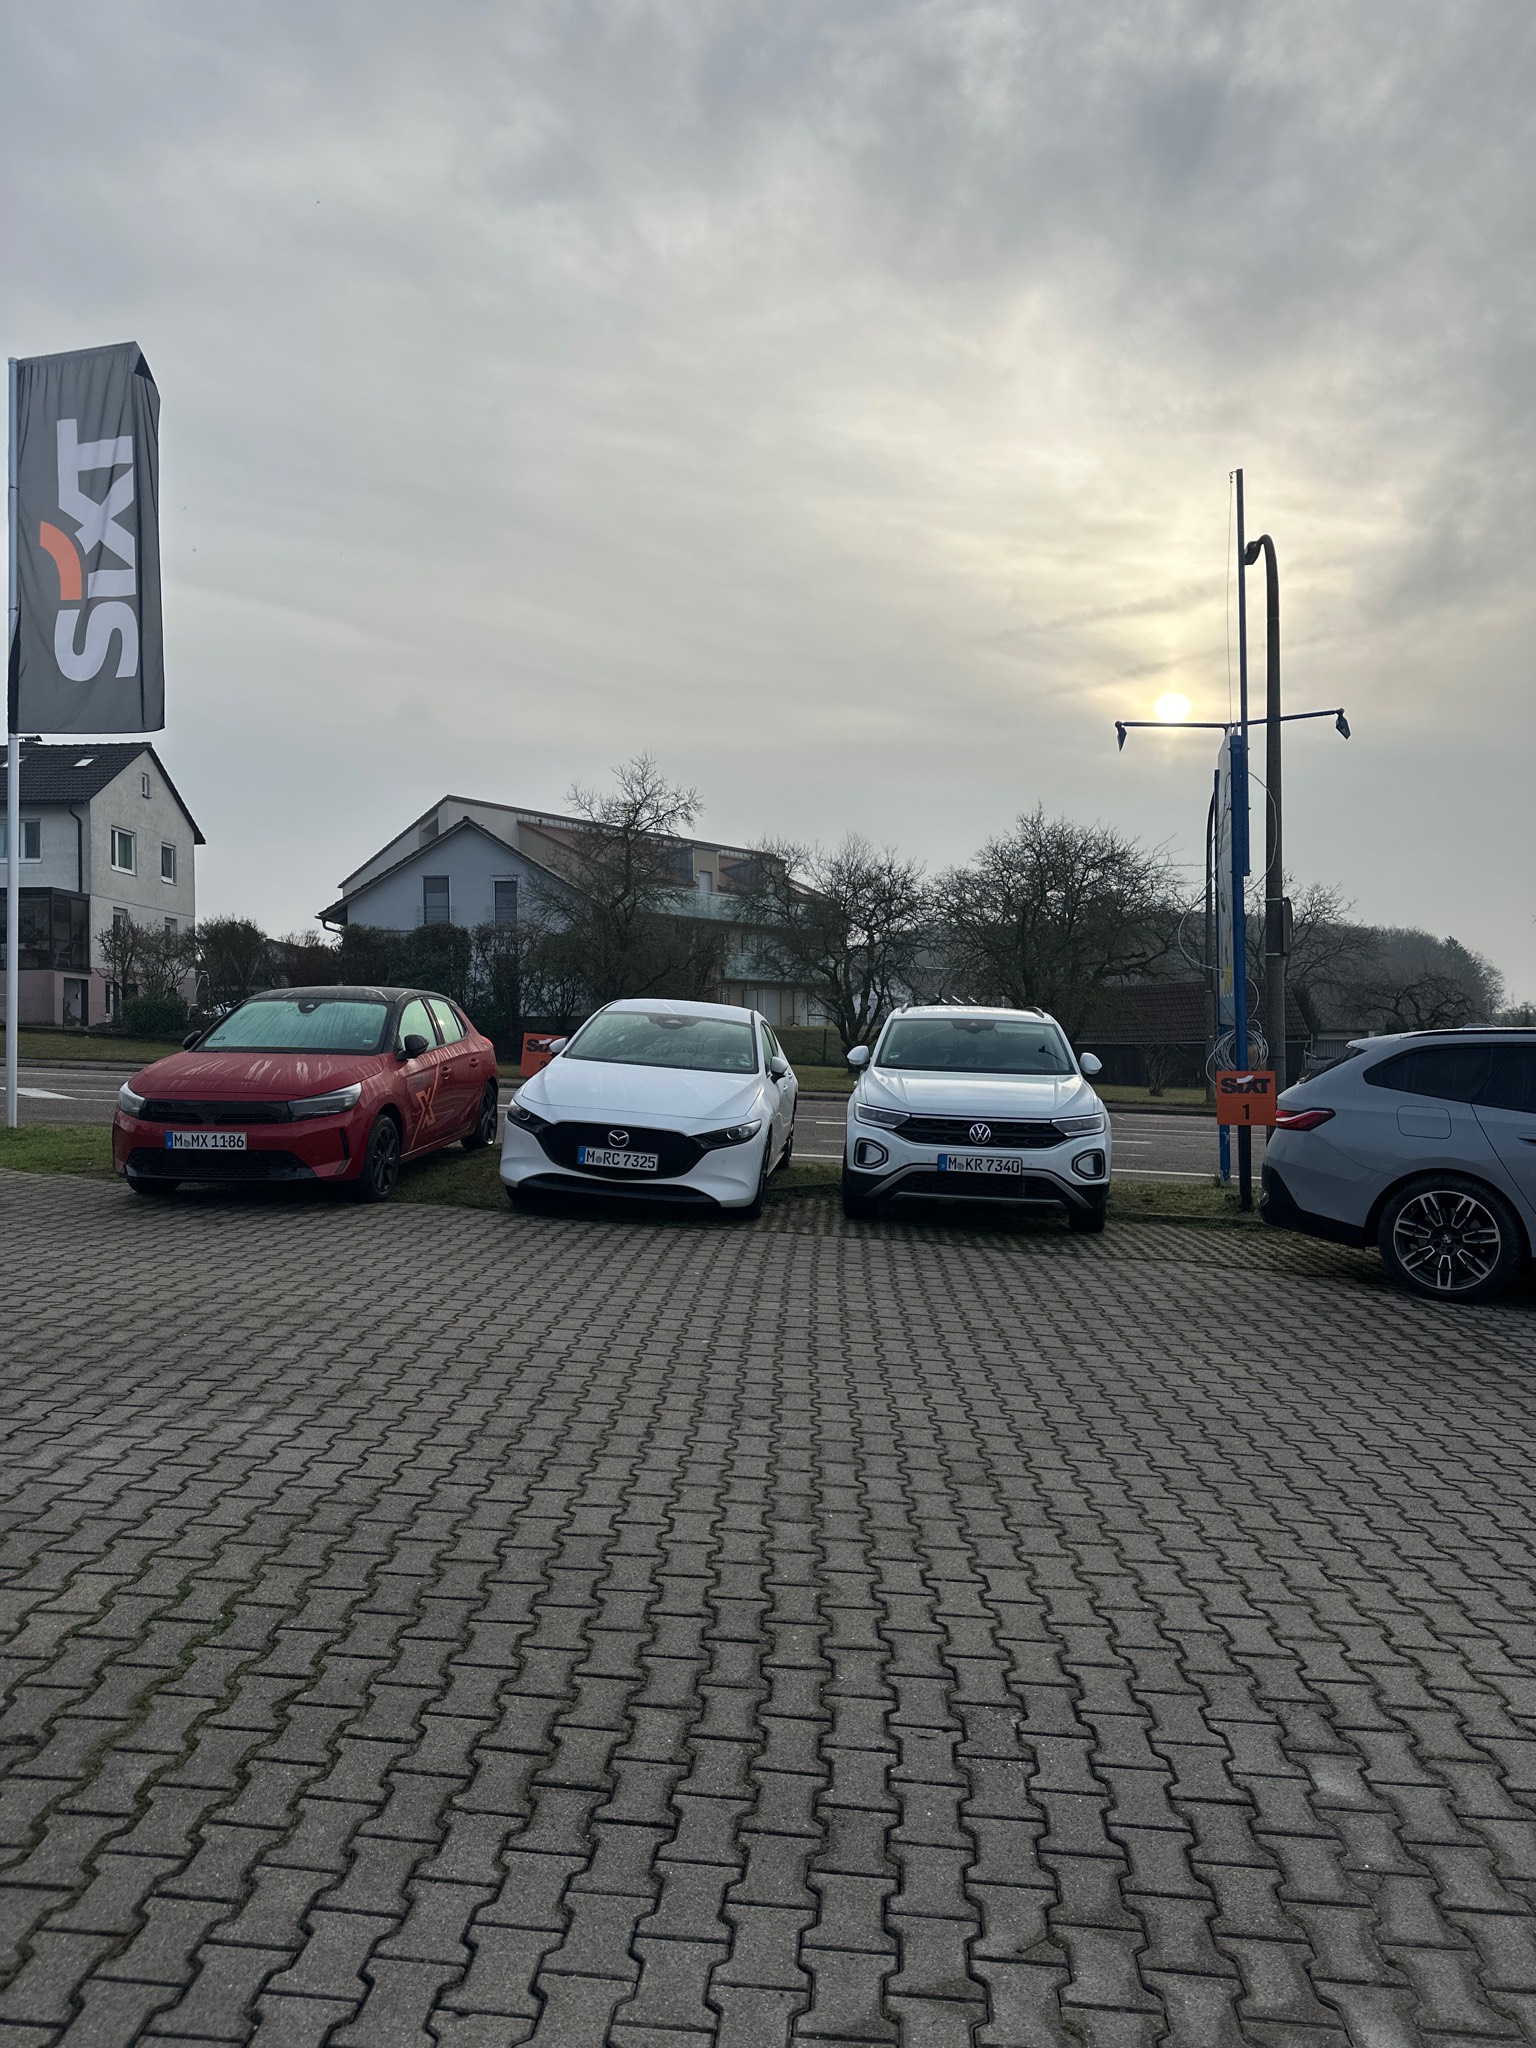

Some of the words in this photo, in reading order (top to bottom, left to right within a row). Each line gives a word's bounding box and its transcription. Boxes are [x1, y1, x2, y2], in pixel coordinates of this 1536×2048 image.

[39, 418, 139, 682] SIXT
[1221, 1075, 1271, 1094] SIXT
[1242, 1104, 1250, 1120] 1
[174, 1134, 183, 1147] M
[191, 1134, 208, 1148] MX
[211, 1135, 245, 1148] 1186
[586, 1149, 595, 1163] M
[603, 1151, 620, 1166] RC
[623, 1154, 656, 1169] 7325
[948, 1157, 957, 1170] M
[965, 1158, 983, 1171] KR
[986, 1159, 1020, 1173] 7340
